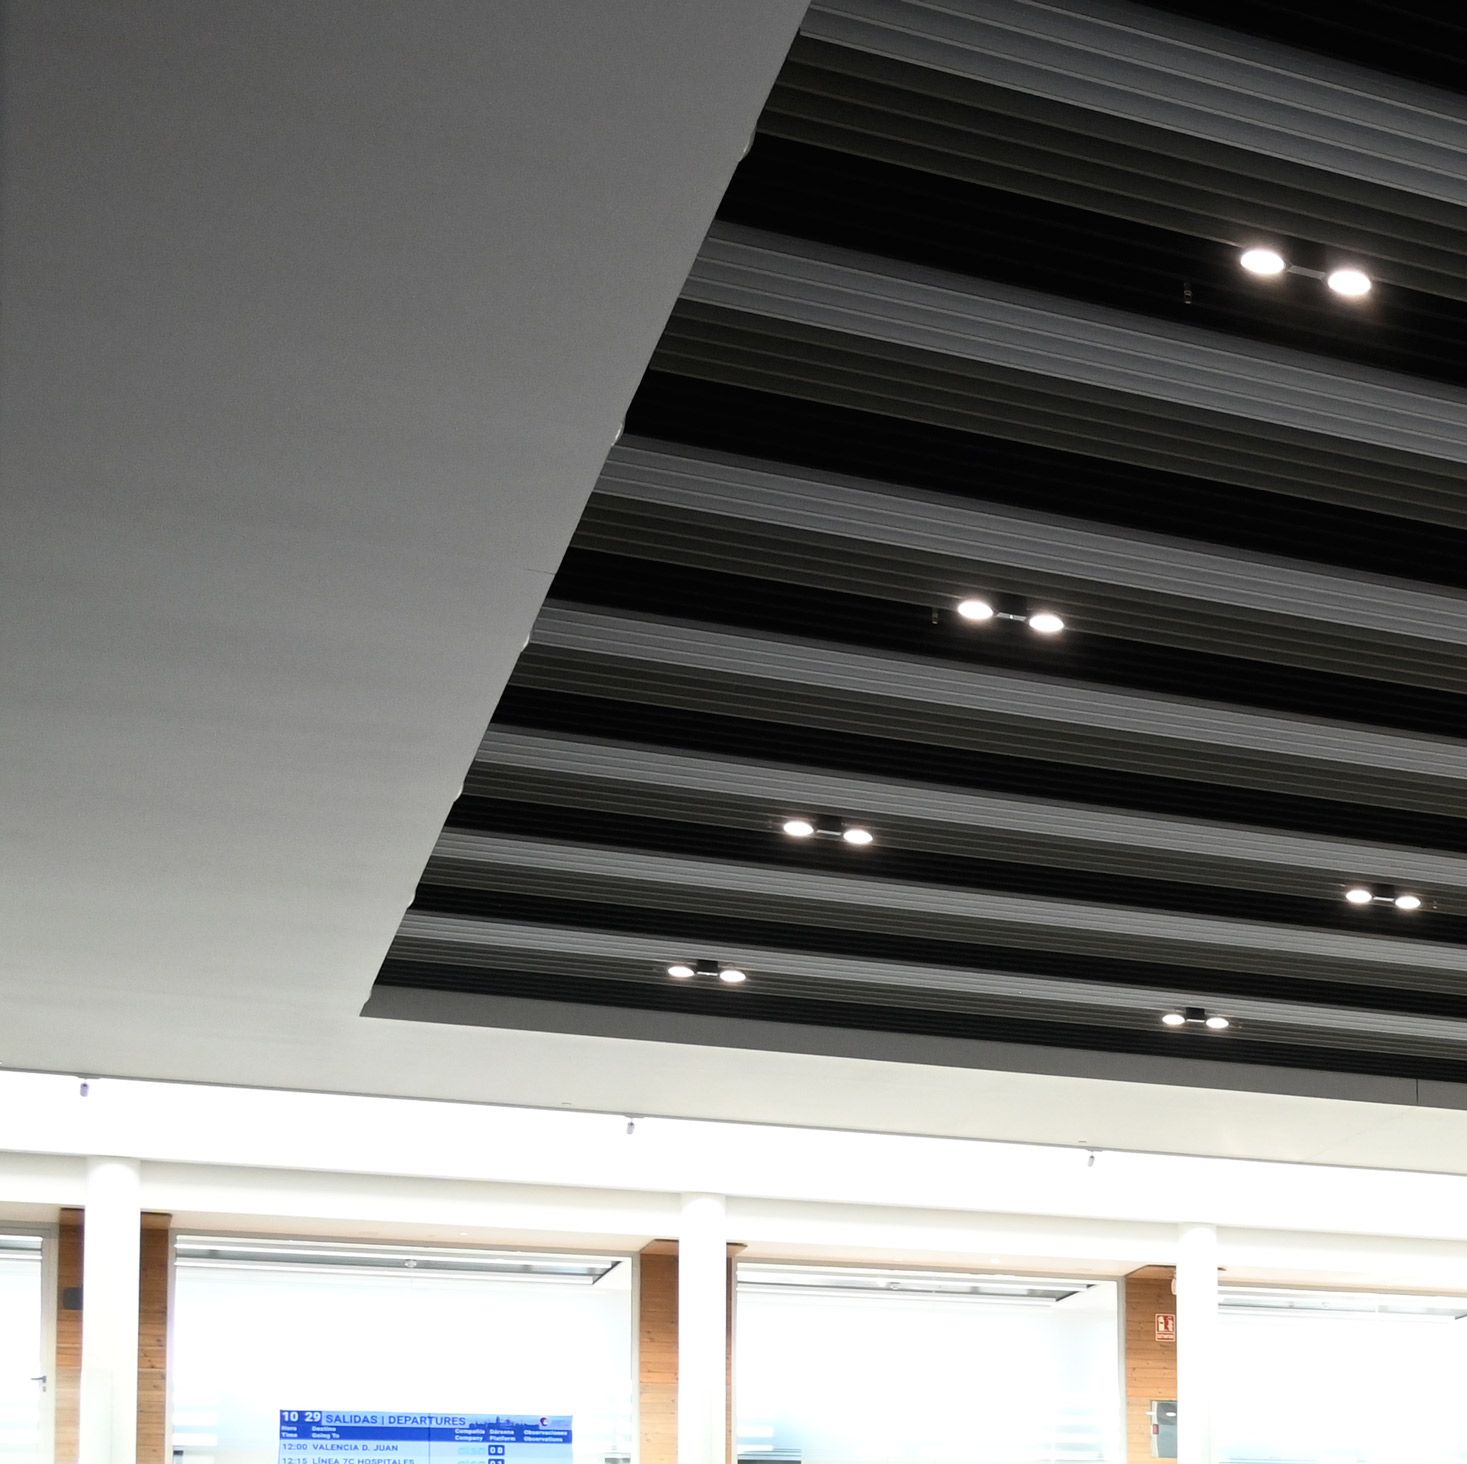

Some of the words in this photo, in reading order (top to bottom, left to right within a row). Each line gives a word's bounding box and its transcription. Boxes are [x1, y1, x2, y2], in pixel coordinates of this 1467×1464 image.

[282, 1411, 299, 1421] 10
[304, 1411, 321, 1422] 29
[325, 1414, 378, 1424] SALIDAS
[388, 1415, 466, 1426] DEPARTURES
[312, 1457, 340, 1464] LÍNEA
